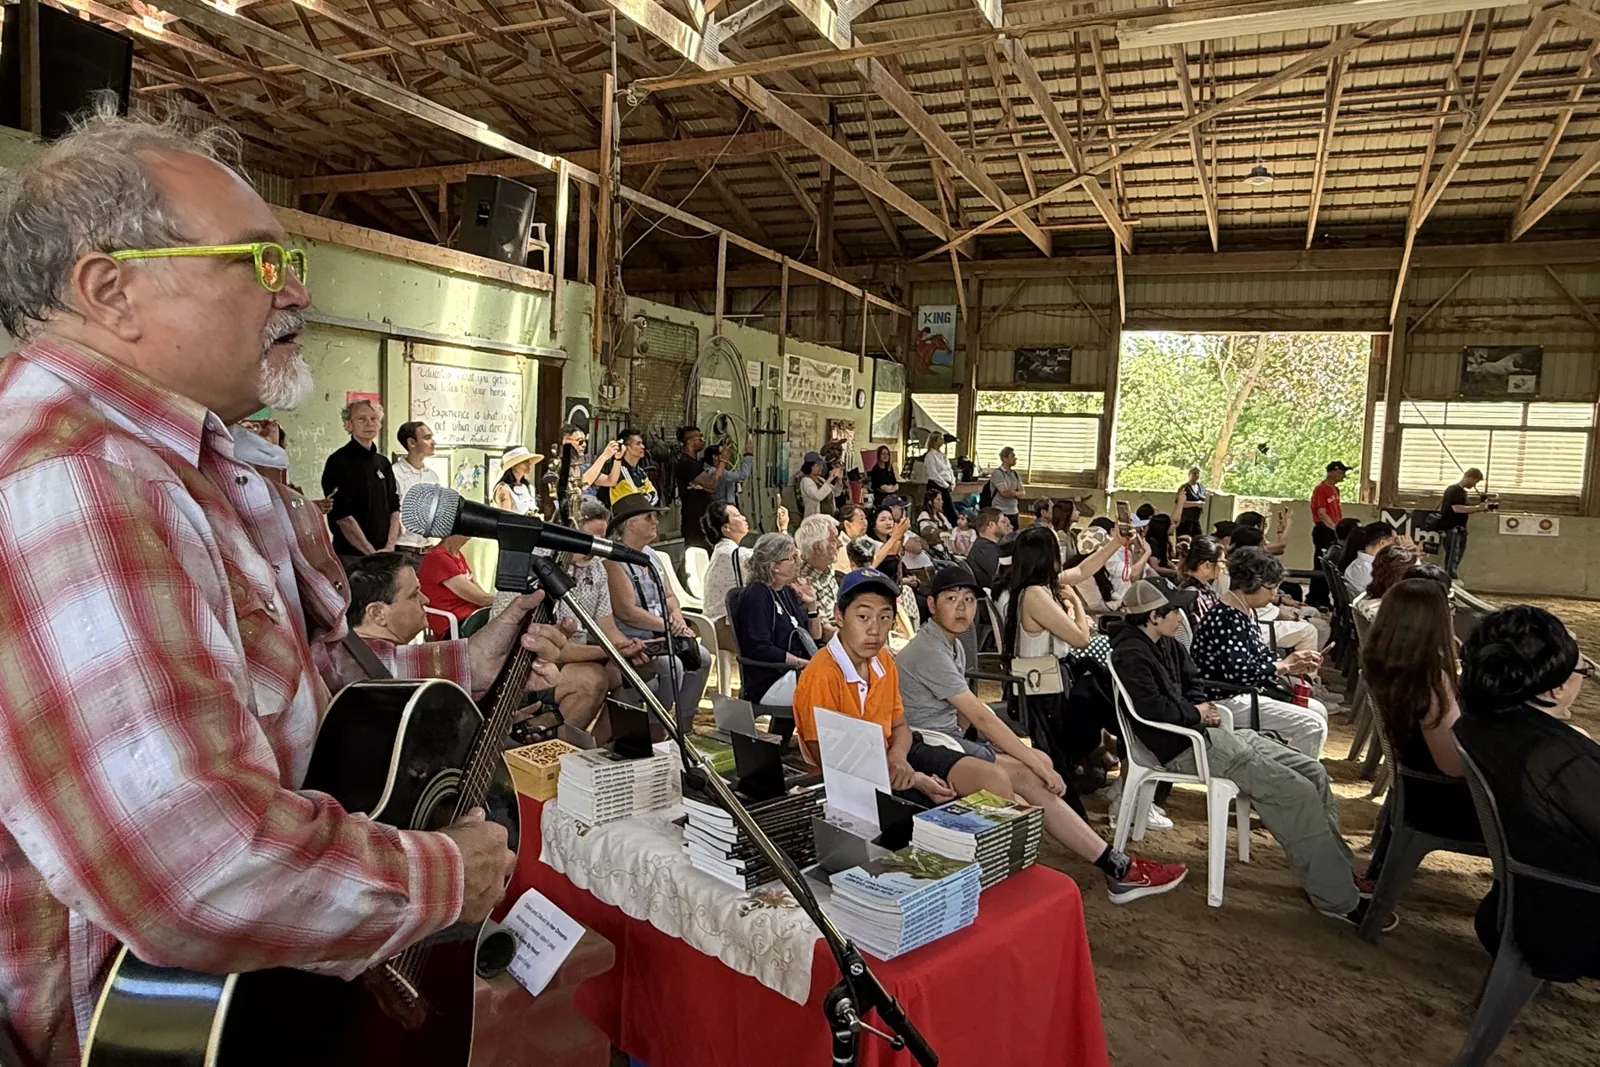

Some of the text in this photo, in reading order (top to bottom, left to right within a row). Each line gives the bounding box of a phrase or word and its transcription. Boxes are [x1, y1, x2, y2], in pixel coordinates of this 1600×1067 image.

[923, 311, 952, 324] KING
[490, 385, 507, 397] horse
[431, 405, 470, 420] Experience
[474, 410, 481, 420] is
[474, 423, 487, 435] you
